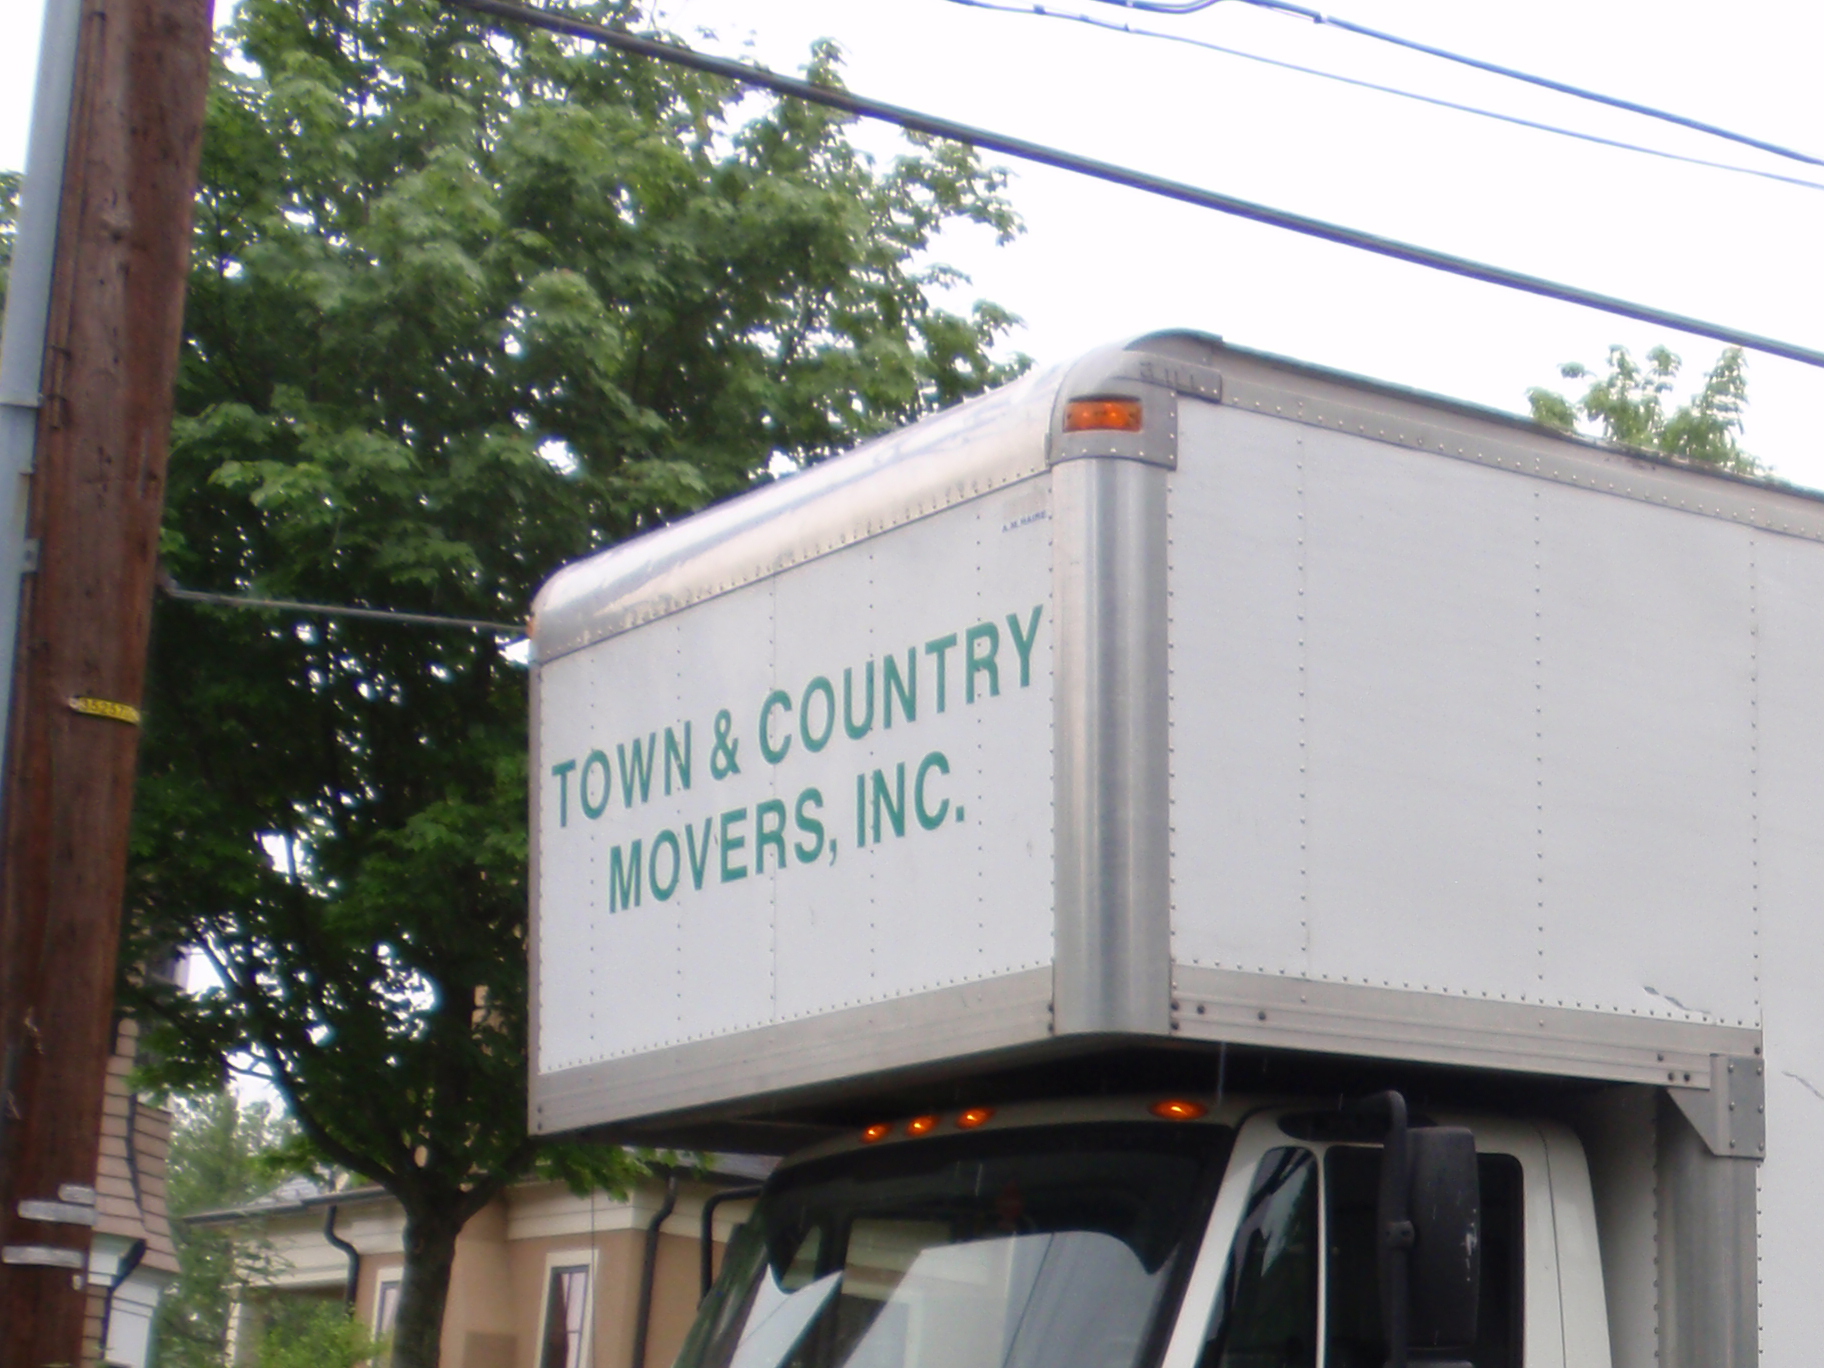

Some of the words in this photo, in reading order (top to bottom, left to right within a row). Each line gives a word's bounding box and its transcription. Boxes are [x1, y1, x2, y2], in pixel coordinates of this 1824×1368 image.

[551, 720, 692, 828] TOWN
[710, 708, 741, 780] &
[759, 604, 1043, 765] COUNTRY
[609, 787, 837, 914] MOVERS,
[856, 751, 964, 847] INC.
